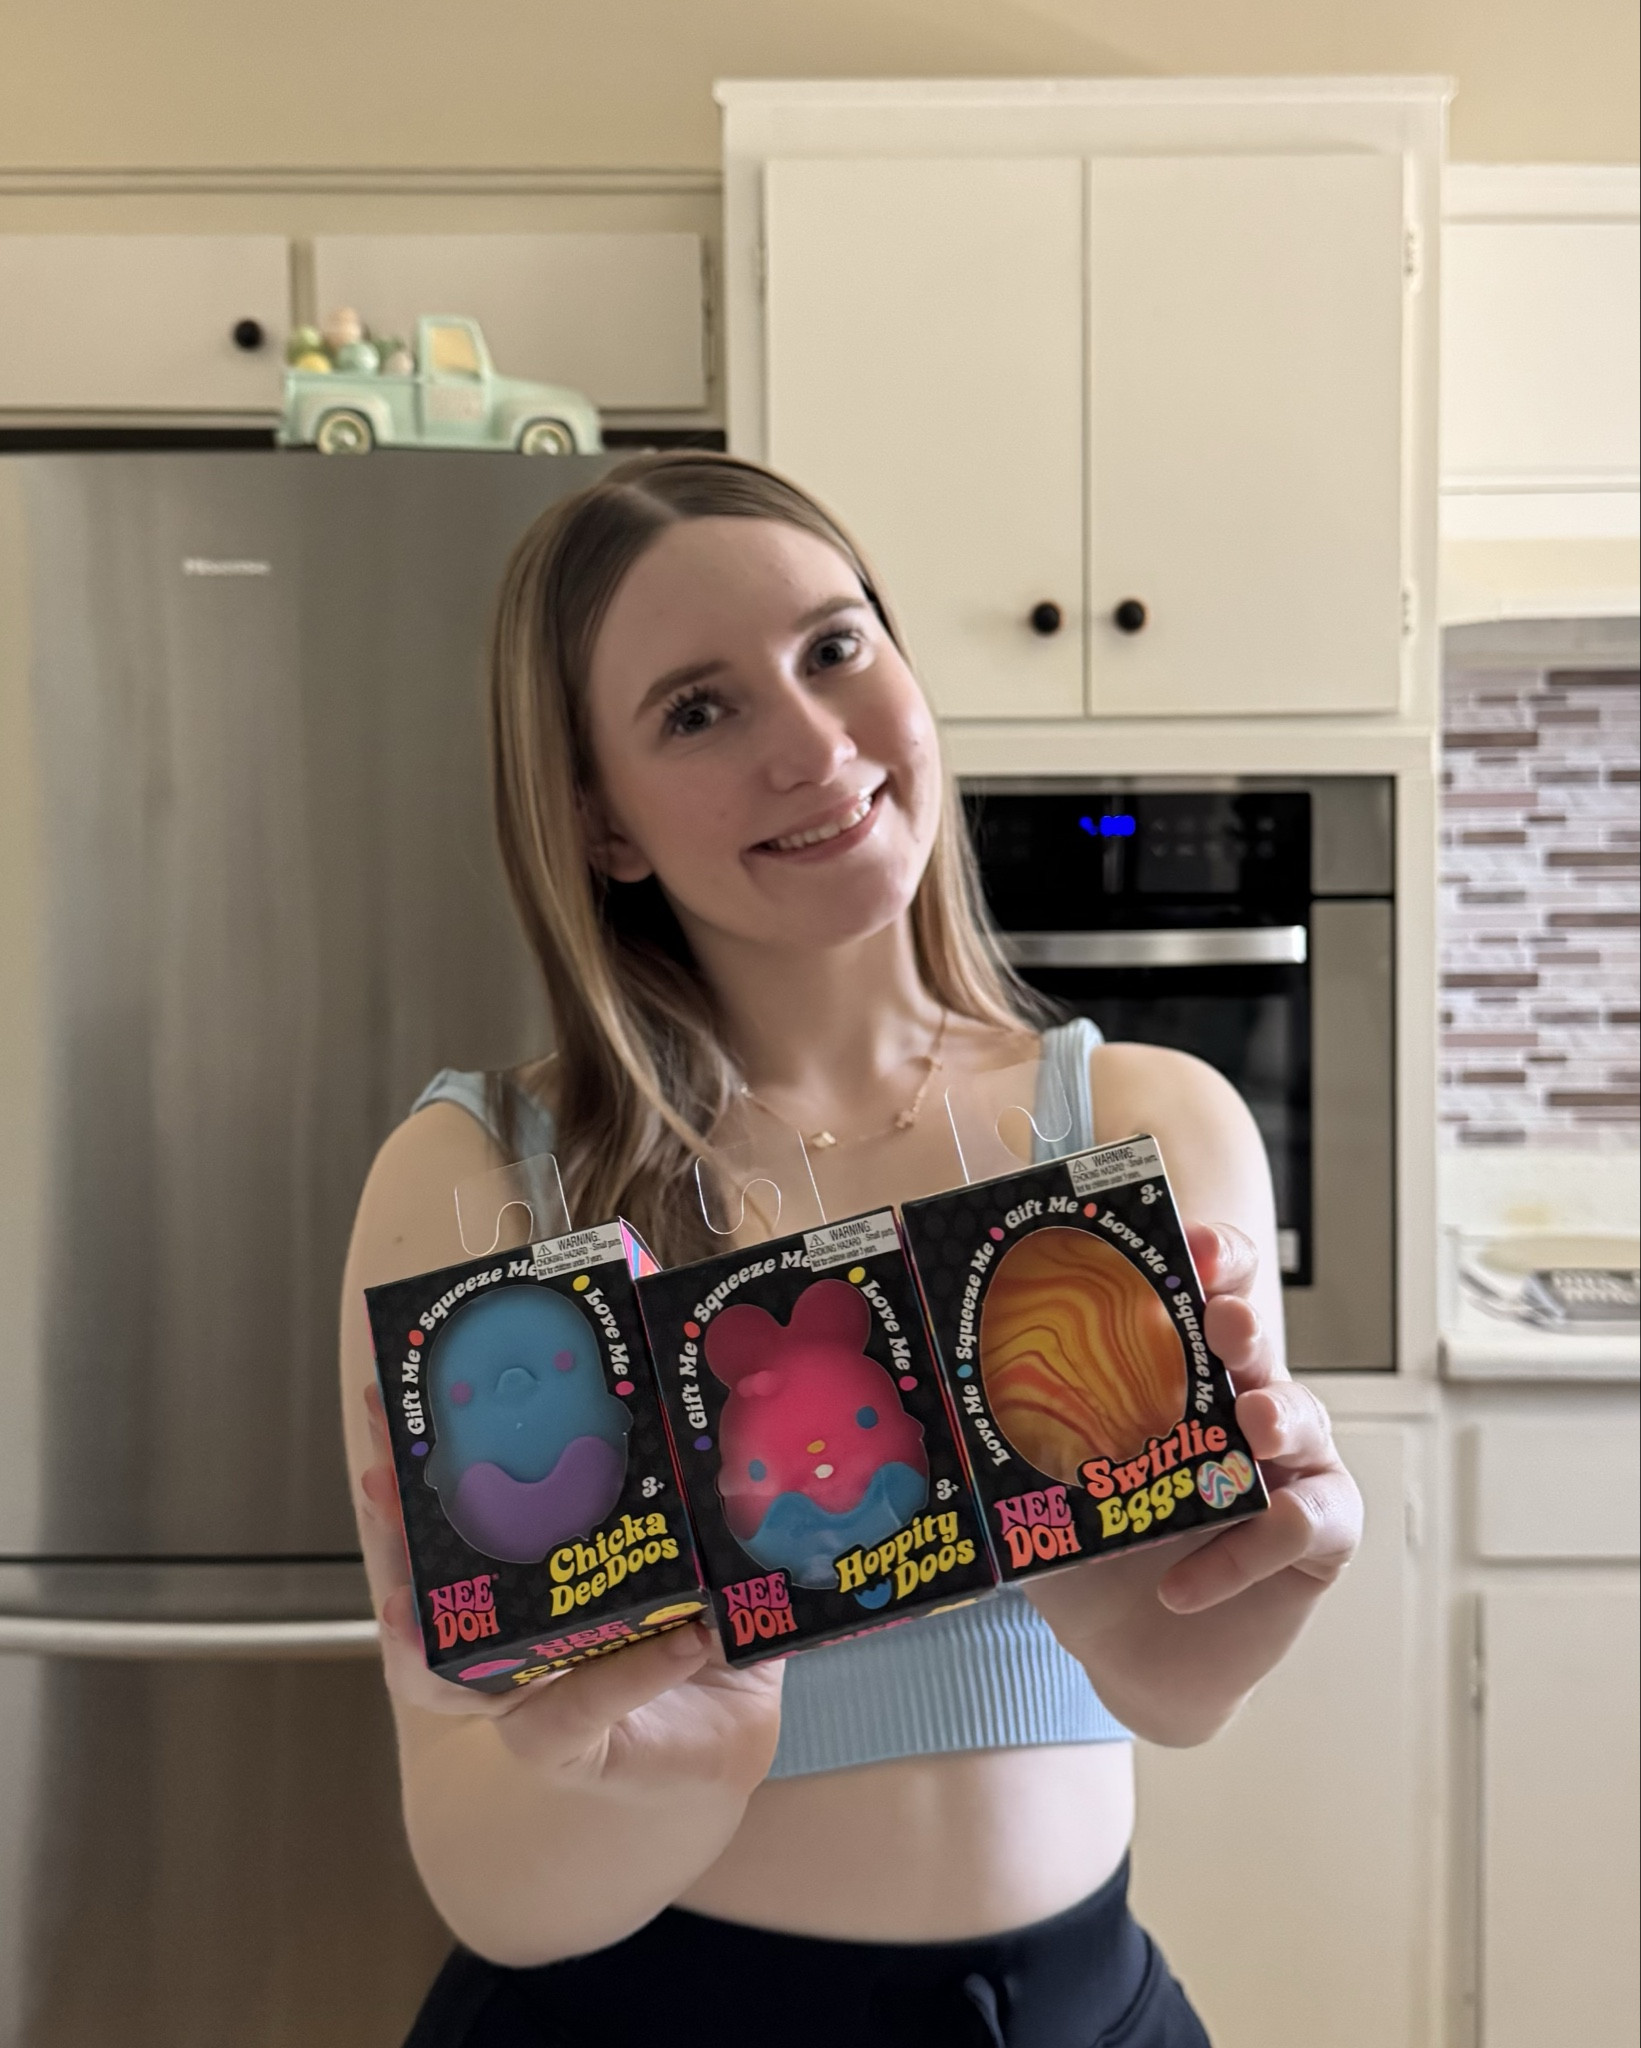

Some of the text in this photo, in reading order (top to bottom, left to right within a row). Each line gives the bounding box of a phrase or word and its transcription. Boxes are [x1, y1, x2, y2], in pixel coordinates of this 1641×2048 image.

[1005, 1196, 1079, 1230] Gift Me
[1140, 1183, 1164, 1205] 3+
[1098, 1209, 1168, 1275] Love Me
[419, 1259, 537, 1330] Squeeze Me
[694, 1250, 811, 1323] Squeeze Me
[955, 1241, 995, 1360] Squeeze Me
[583, 1287, 630, 1375] Love Me
[860, 1279, 912, 1370] Love Me
[1173, 1291, 1214, 1414] Squeeze Me
[402, 1349, 426, 1435] Gift Me
[679, 1342, 708, 1429] Gift Me
[962, 1383, 1012, 1467] Love Me
[1082, 1419, 1228, 1499] Swirlie
[641, 1476, 665, 1498] 3+
[936, 1478, 960, 1500] 3+
[994, 1485, 1072, 1535] NEE
[1096, 1467, 1195, 1538] Eggs
[549, 1512, 668, 1583] Chicka
[549, 1537, 680, 1617] DeeDoos
[835, 1511, 958, 1594] Hoppity
[894, 1538, 976, 1600] Doos
[1003, 1521, 1082, 1569] DOH
[428, 1574, 493, 1621] NEE
[434, 1606, 500, 1650] DOH
[721, 1572, 791, 1618] NEE
[730, 1603, 798, 1647] DOH
